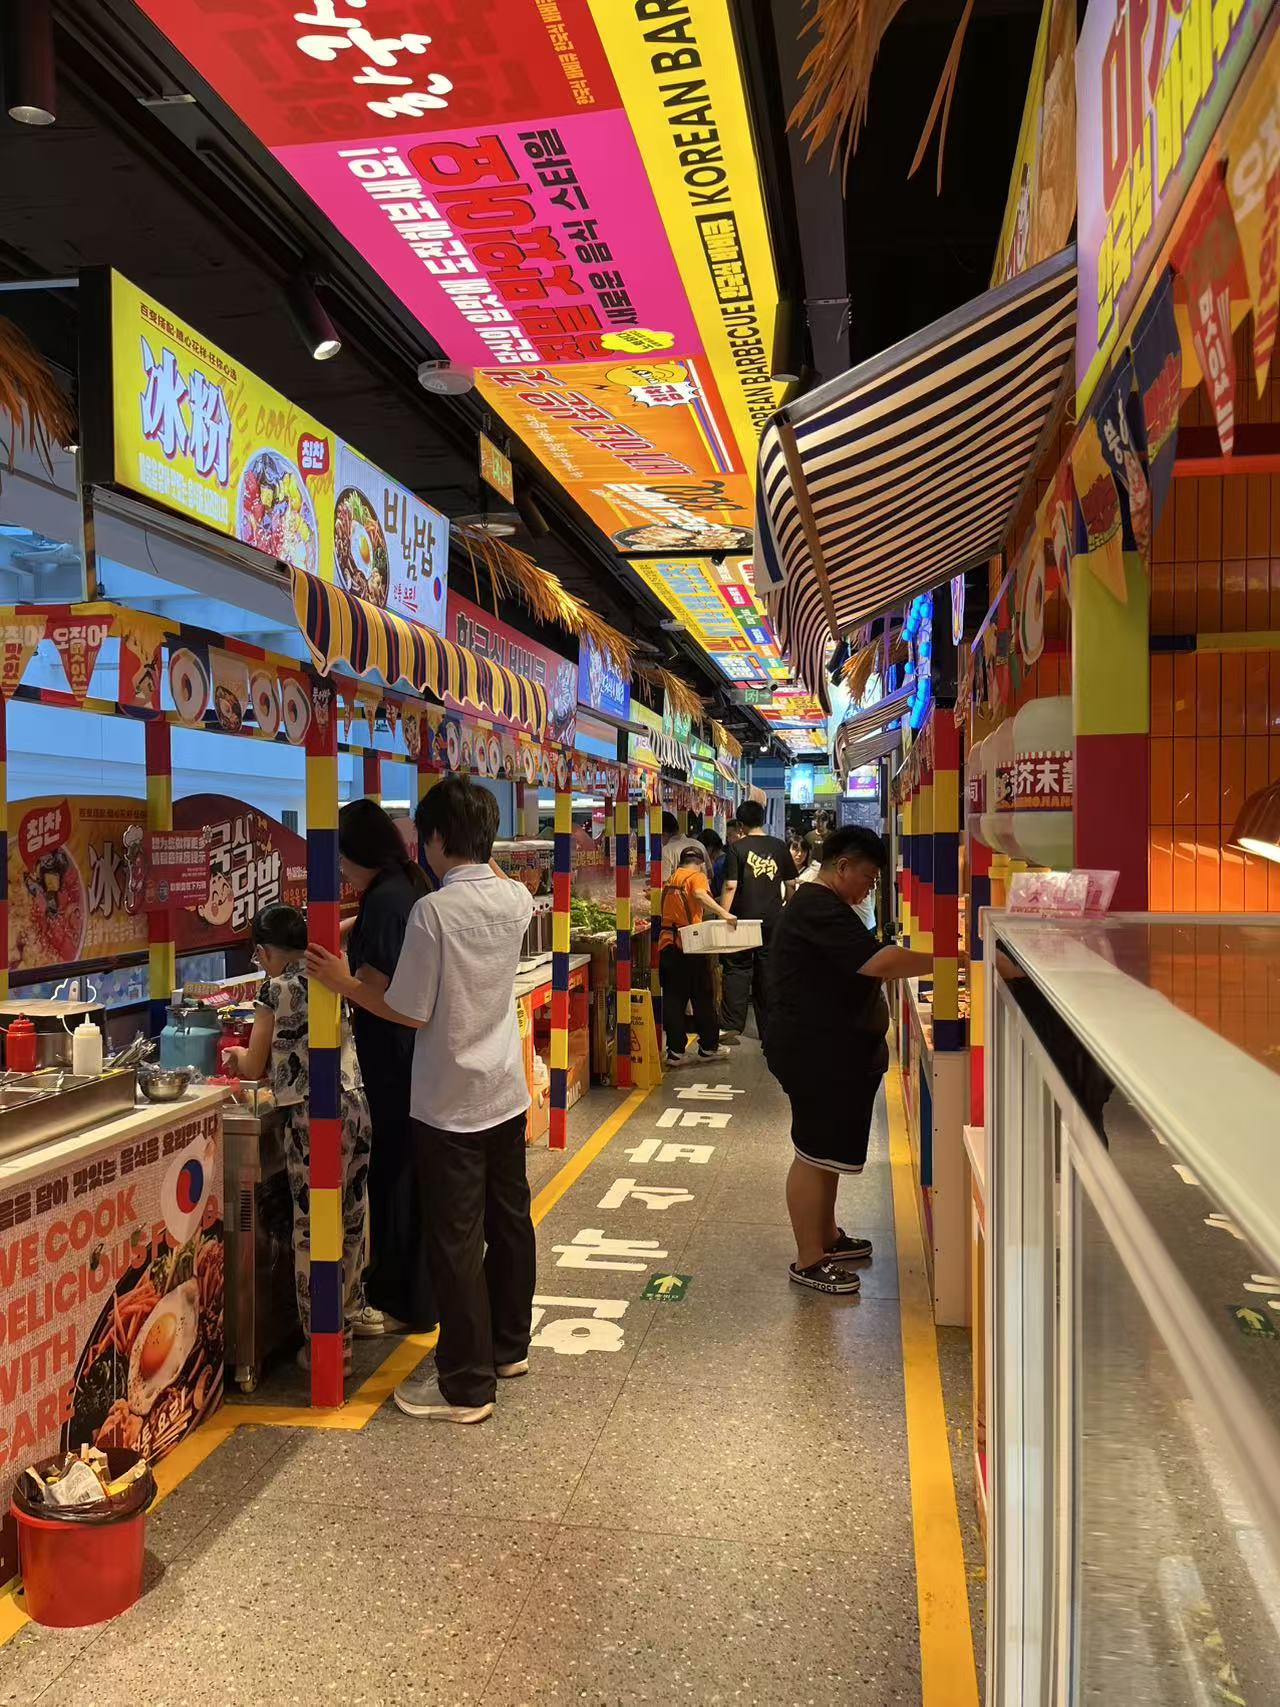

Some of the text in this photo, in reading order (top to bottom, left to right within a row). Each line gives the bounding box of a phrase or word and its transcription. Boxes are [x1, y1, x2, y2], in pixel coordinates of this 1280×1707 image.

[536, 0, 563, 21] 바비
[660, 80, 732, 205] KOREAN
[405, 136, 586, 301] 맛있어요
[518, 127, 637, 324] 새로운 음식 스타일
[336, 144, 541, 362] 당신의 입맛에 도전해보세요!
[520, 303, 604, 360] 정말
[726, 304, 772, 387] BARBECUE
[140, 335, 230, 487] 冰粉
[516, 390, 617, 421] 싶은
[569, 423, 656, 449] 하고
[302, 439, 326, 470] 칭찬
[614, 452, 696, 475] 내가
[384, 487, 436, 582] 비빔밥
[0, 625, 46, 648] 징어
[27, 809, 62, 853] 칭찬
[36, 1177, 69, 1215] 담아
[73, 1159, 117, 1198] 맛있는
[121, 1137, 159, 1176] 음식을
[45, 1184, 137, 1262] COOK
[156, 1386, 188, 1434] 요리
